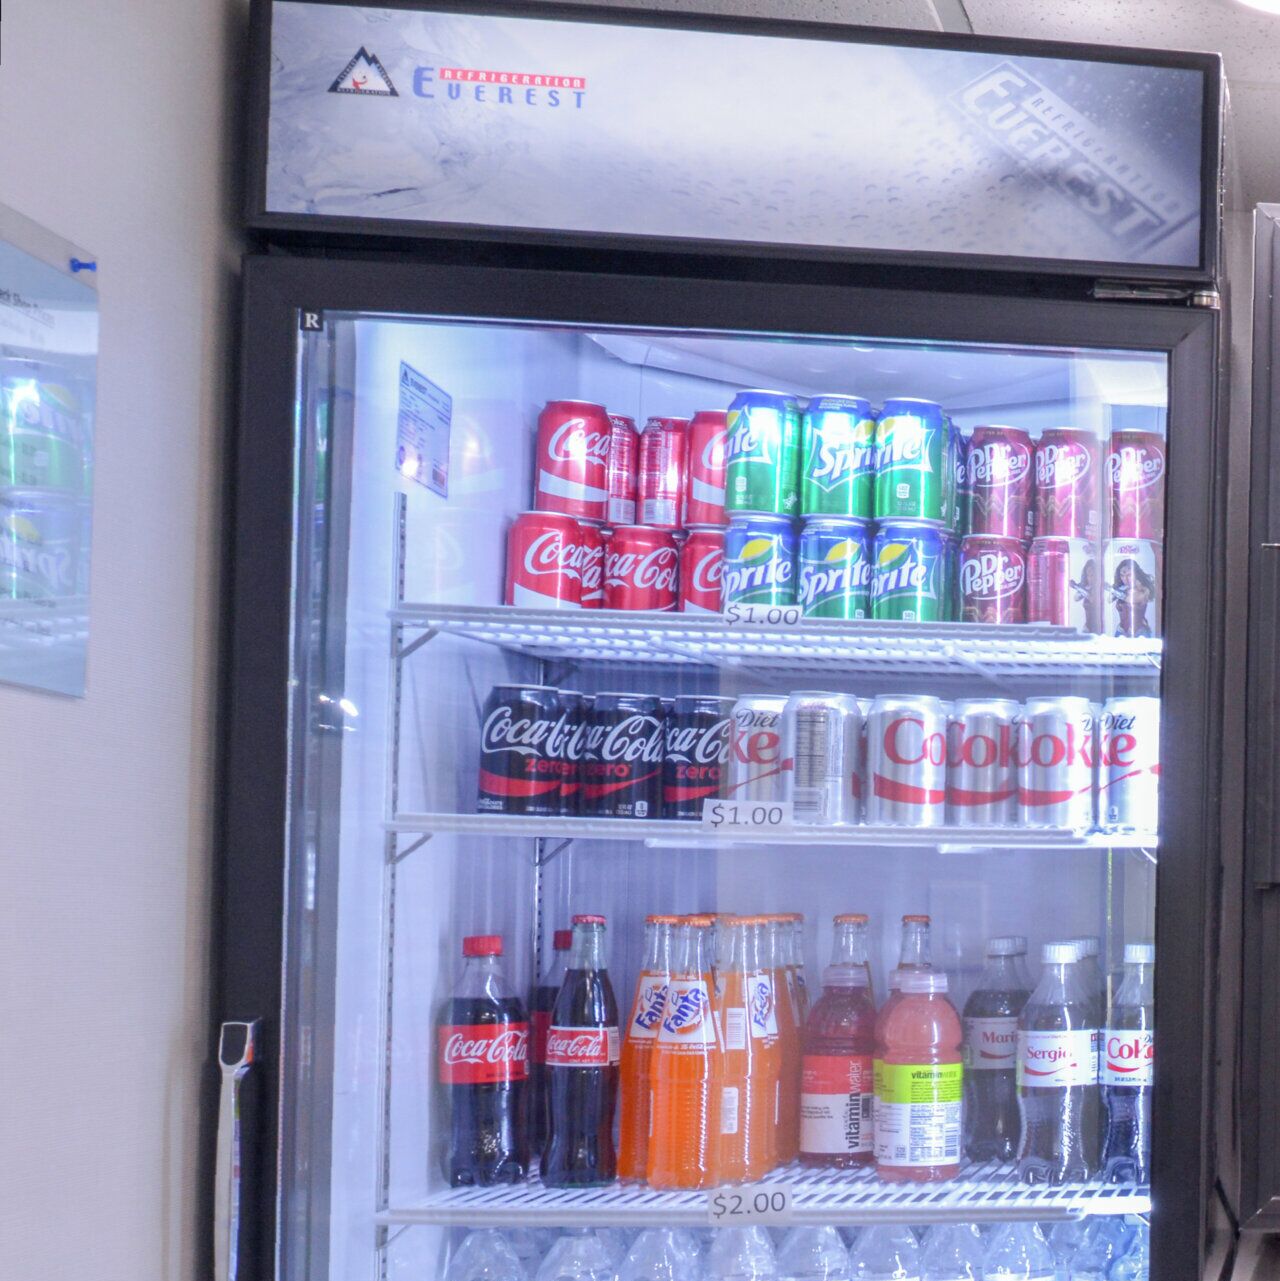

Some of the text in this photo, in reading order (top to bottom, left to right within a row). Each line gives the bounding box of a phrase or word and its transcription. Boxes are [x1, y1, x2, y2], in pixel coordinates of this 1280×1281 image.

[413, 66, 585, 108] EVEREST
[443, 69, 582, 88] REFRIGERATION
[305, 314, 319, 327] R
[982, 553, 1010, 574] Dr
[726, 604, 800, 627] $1.00
[710, 805, 784, 828] $1.00
[663, 987, 706, 1034] Fanta
[445, 1029, 528, 1064] Coca-Cola
[712, 1191, 786, 1219] $2.00
